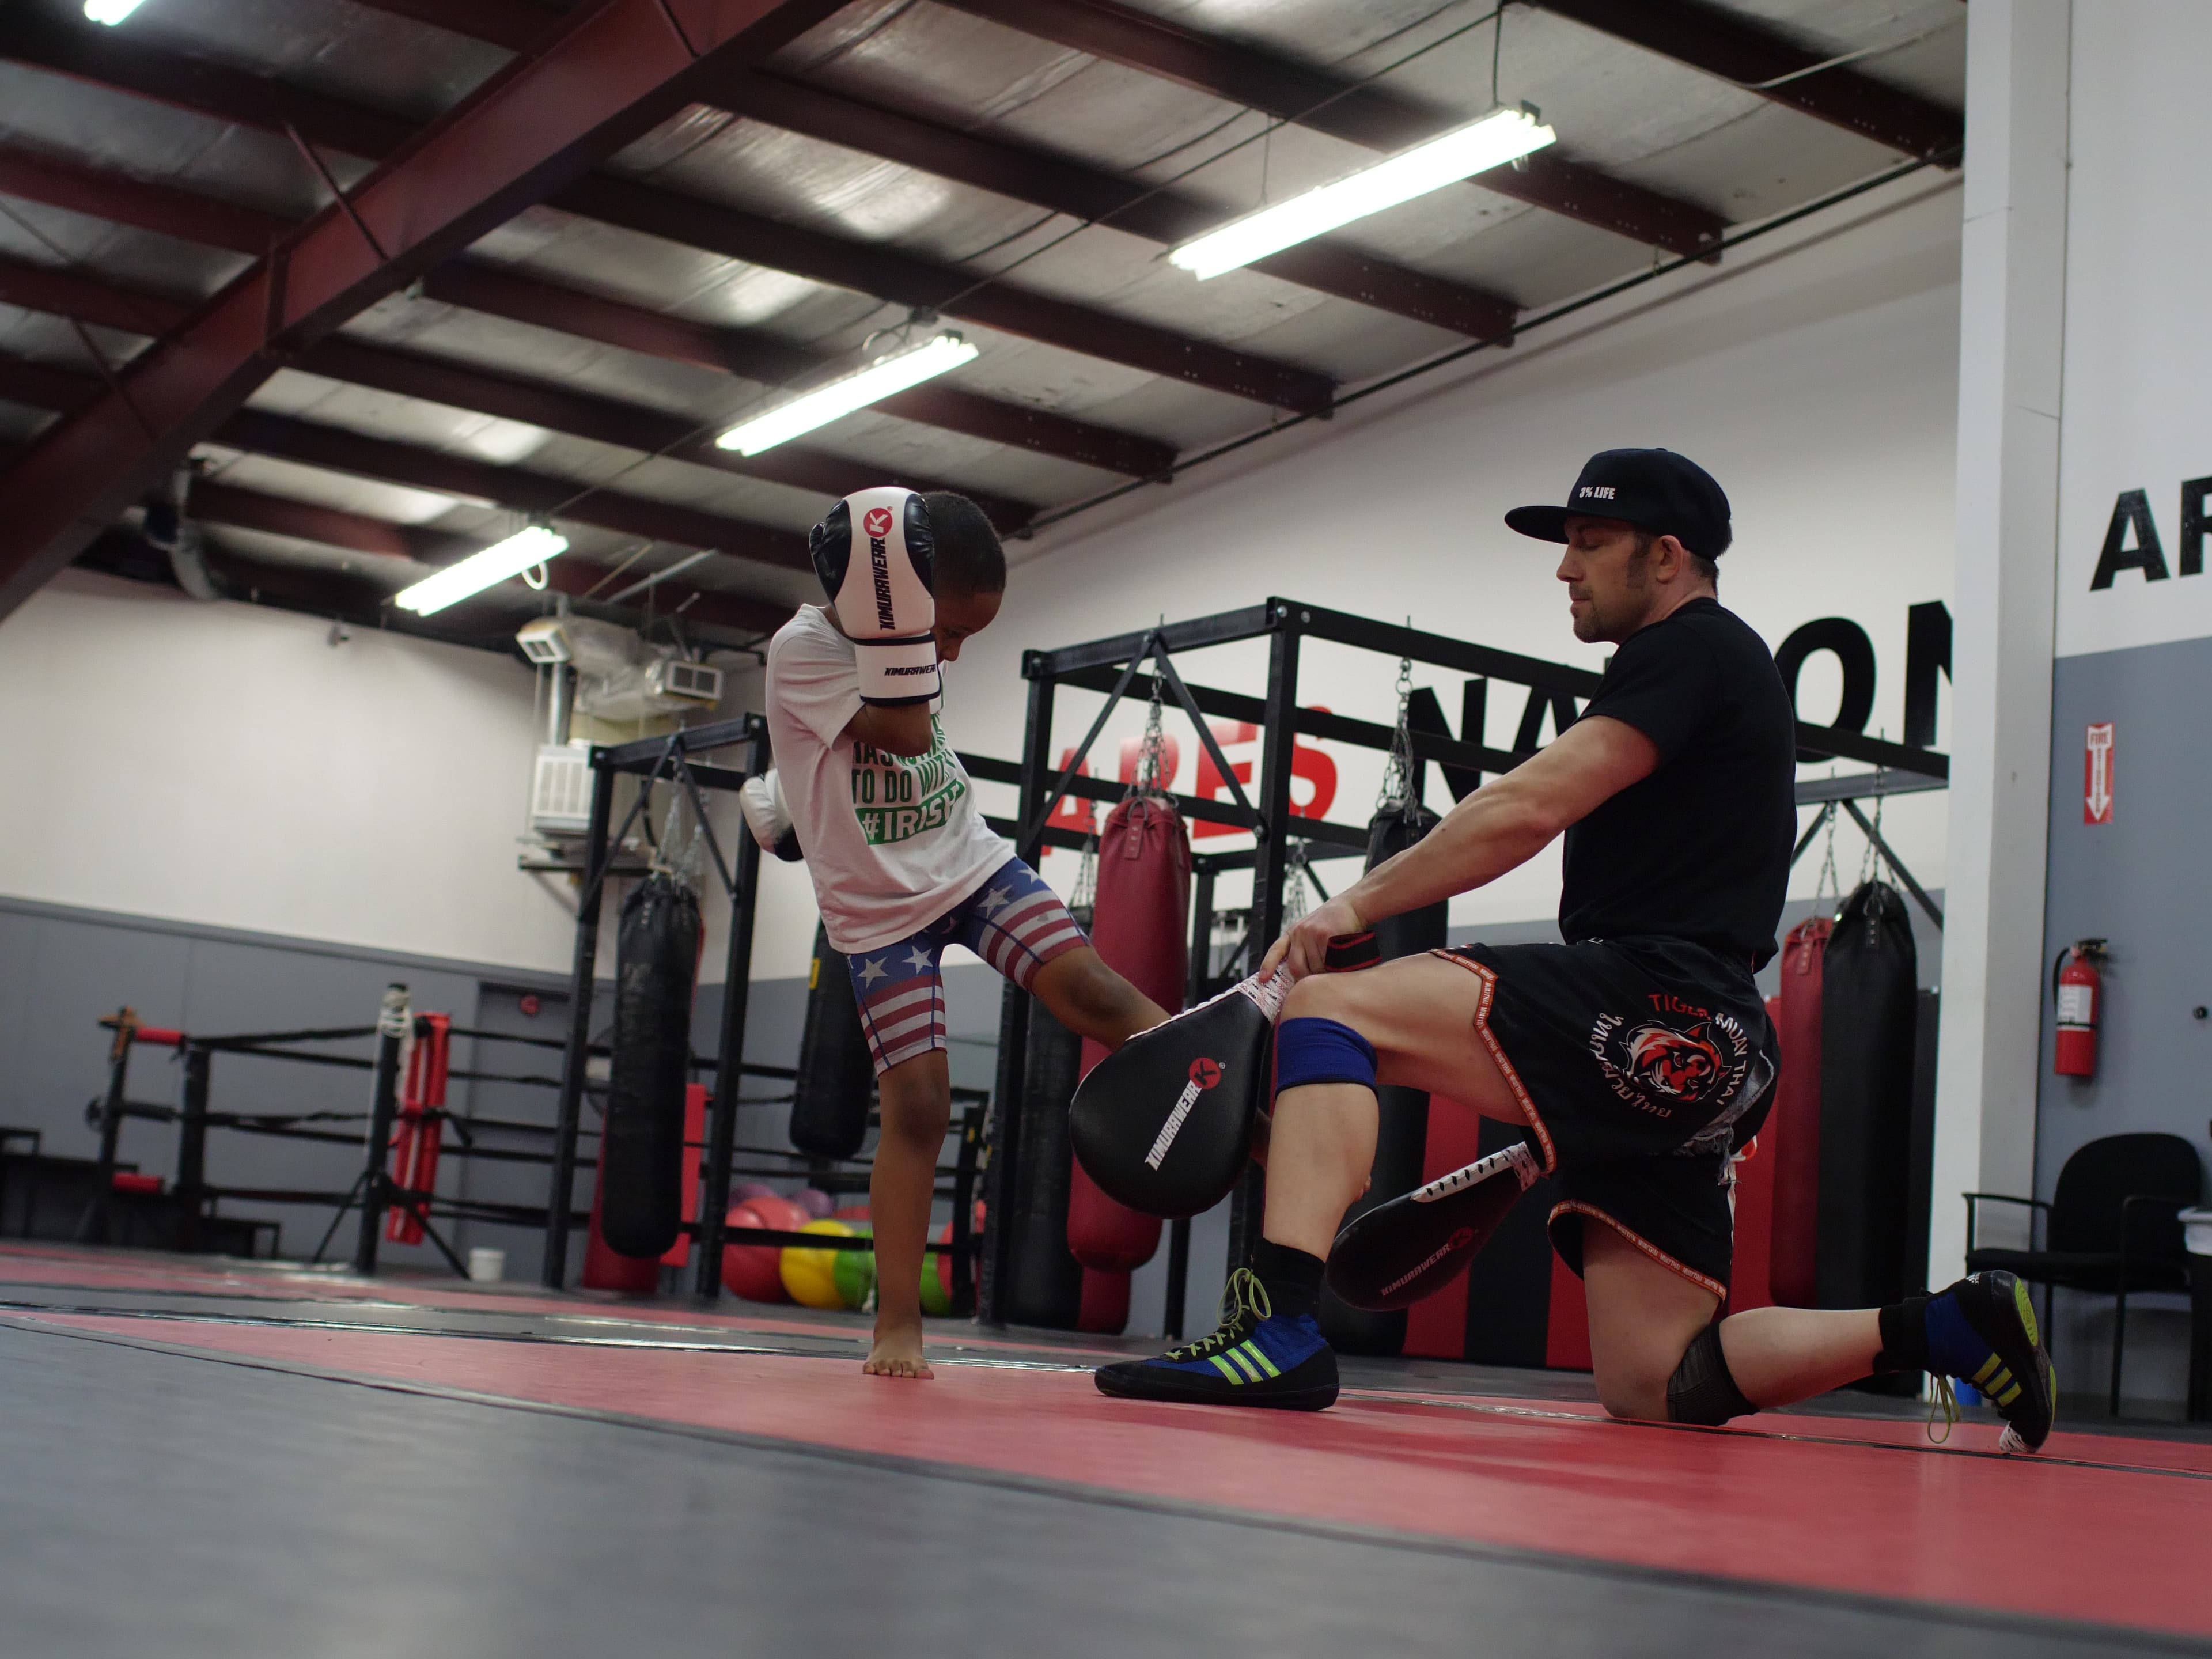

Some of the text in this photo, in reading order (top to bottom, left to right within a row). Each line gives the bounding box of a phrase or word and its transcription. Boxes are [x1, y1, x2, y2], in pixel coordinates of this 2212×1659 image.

[1579, 487, 1616, 500] 3% LIFE
[870, 537, 895, 630] KIMURAWEAR
[851, 768, 875, 804] TO
[884, 770, 912, 803] DO
[1715, 1012, 1748, 1056] MUAY
[1144, 1080, 1202, 1171] KIMURAWEAR
[1380, 1243, 1452, 1296] KIMURAWEAR
